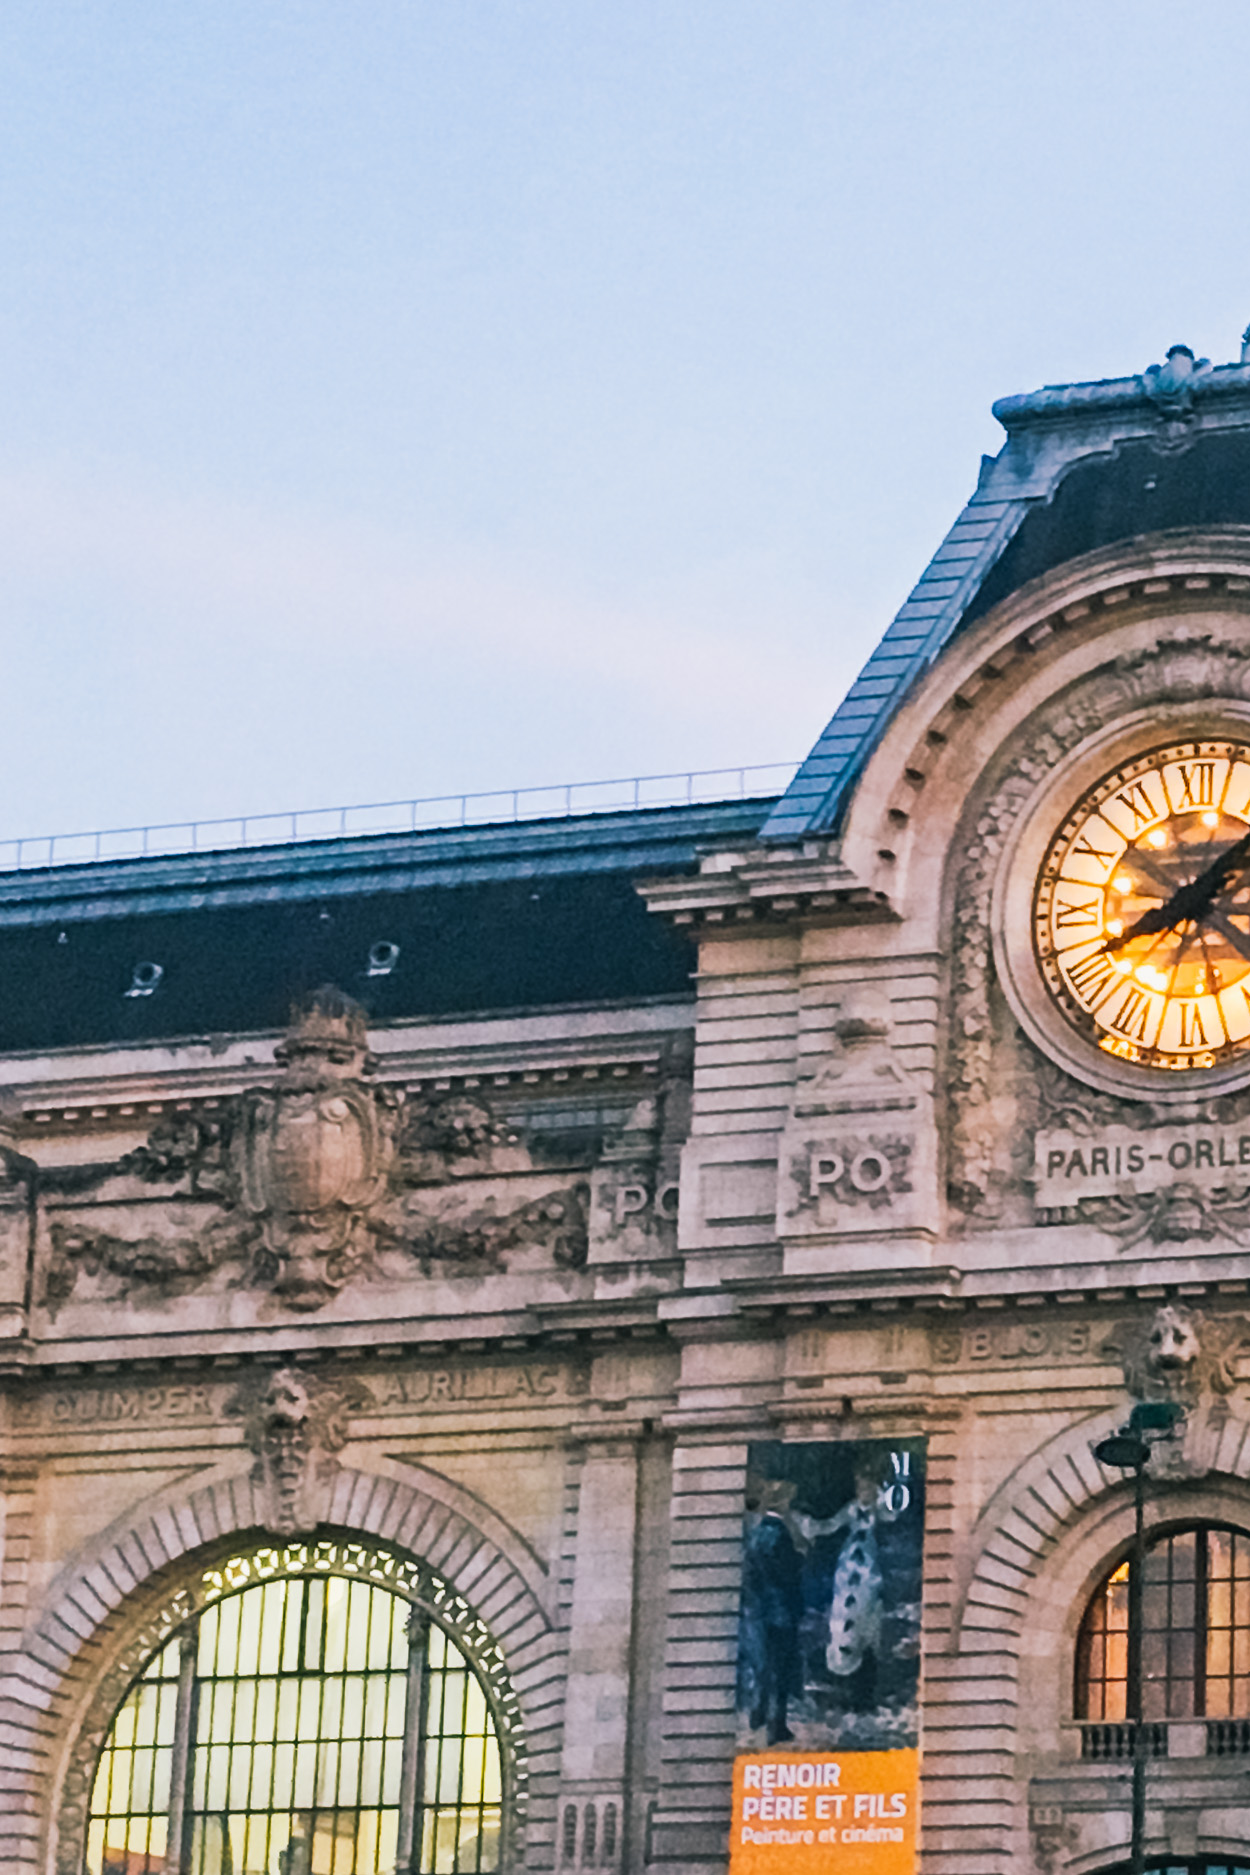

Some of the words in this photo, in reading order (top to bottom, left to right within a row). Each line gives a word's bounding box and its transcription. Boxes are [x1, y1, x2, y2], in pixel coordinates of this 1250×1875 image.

[1177, 763, 1216, 808] XII
[1116, 781, 1157, 832] XI
[1073, 835, 1116, 870] X
[1056, 898, 1099, 929] IX
[1179, 1004, 1209, 1047] VI
[810, 1150, 892, 1197] PO
[52, 1387, 213, 1422] QUIMPER
[381, 1368, 558, 1406] AURILLAC
[743, 1762, 841, 1789] RENOIR
[742, 1787, 809, 1821] PÈRE
[815, 1794, 848, 1819] ET
[854, 1793, 907, 1819] FILS
[741, 1825, 815, 1845] Peinture
[818, 1826, 837, 1844] et
[841, 1823, 904, 1844] cinéma
